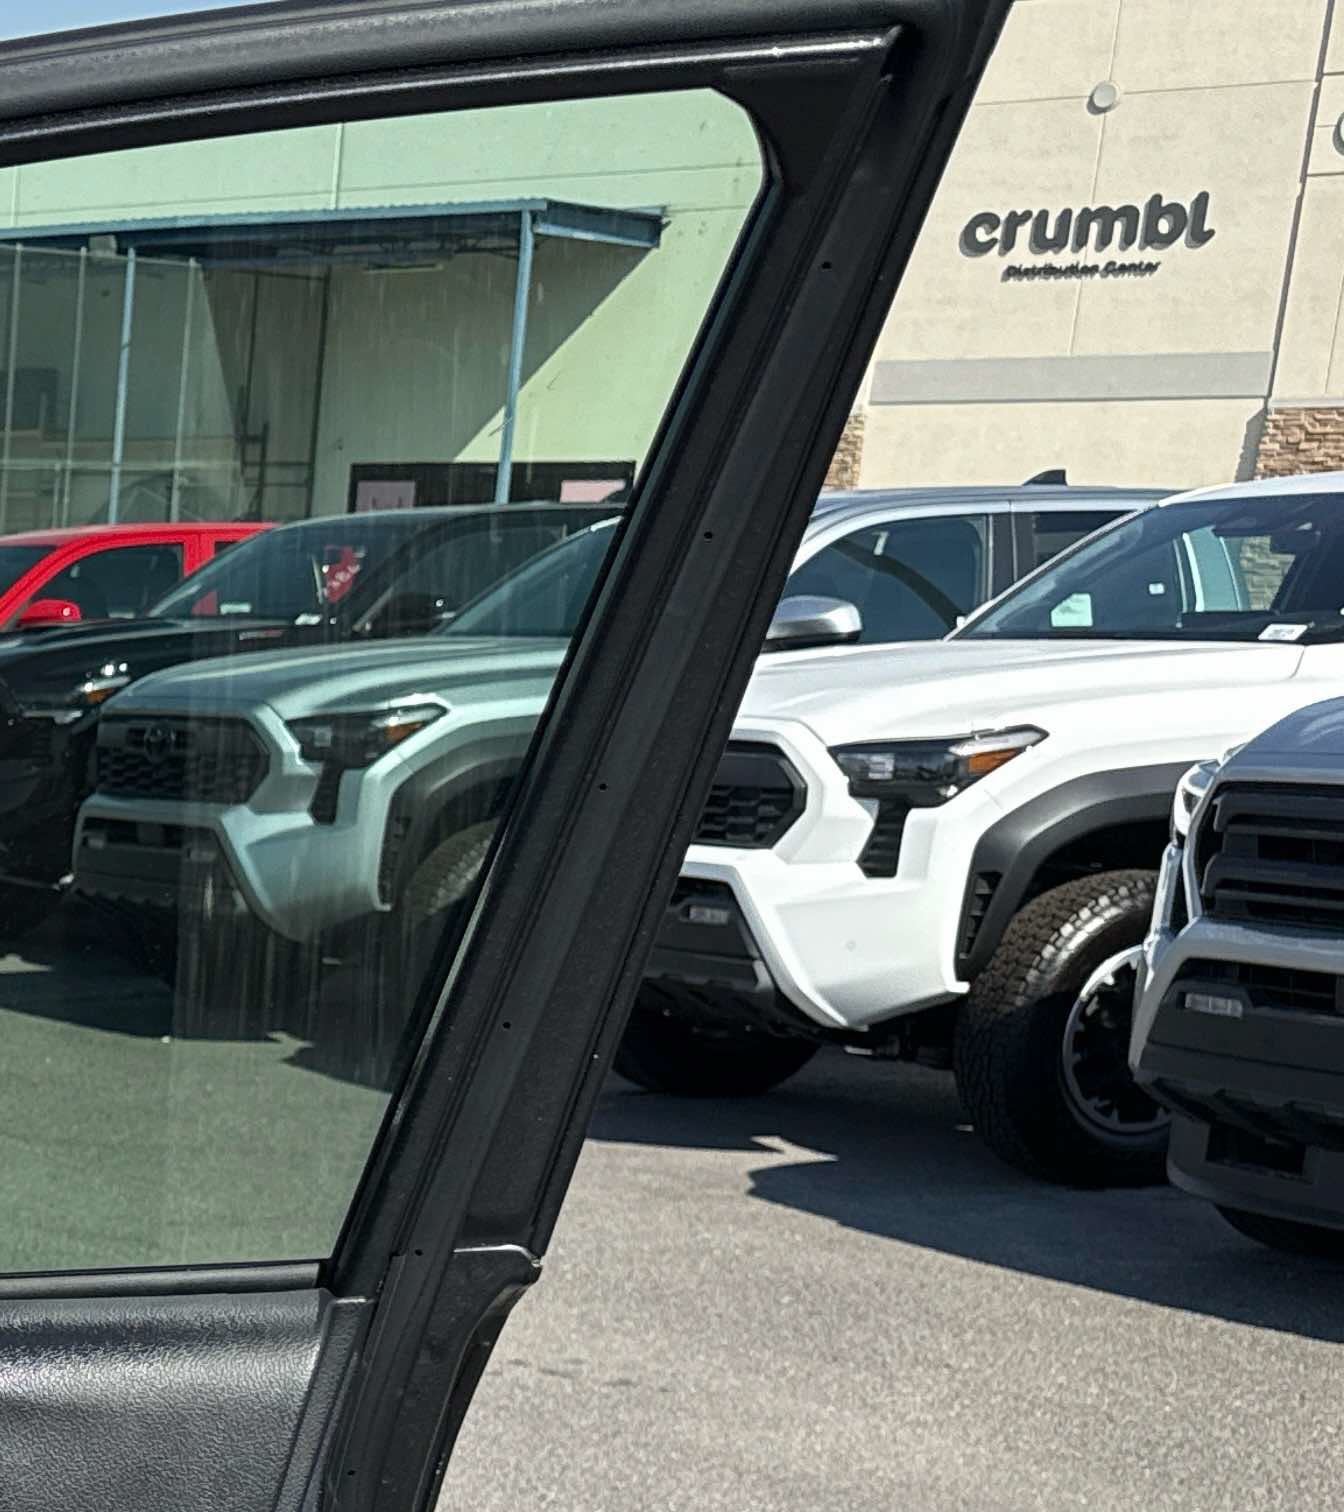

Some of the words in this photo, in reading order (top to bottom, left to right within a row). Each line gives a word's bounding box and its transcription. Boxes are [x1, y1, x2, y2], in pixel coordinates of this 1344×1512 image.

[961, 190, 1216, 254] crumbl
[1004, 262, 1100, 280] Distribution
[1102, 260, 1161, 277] Center
